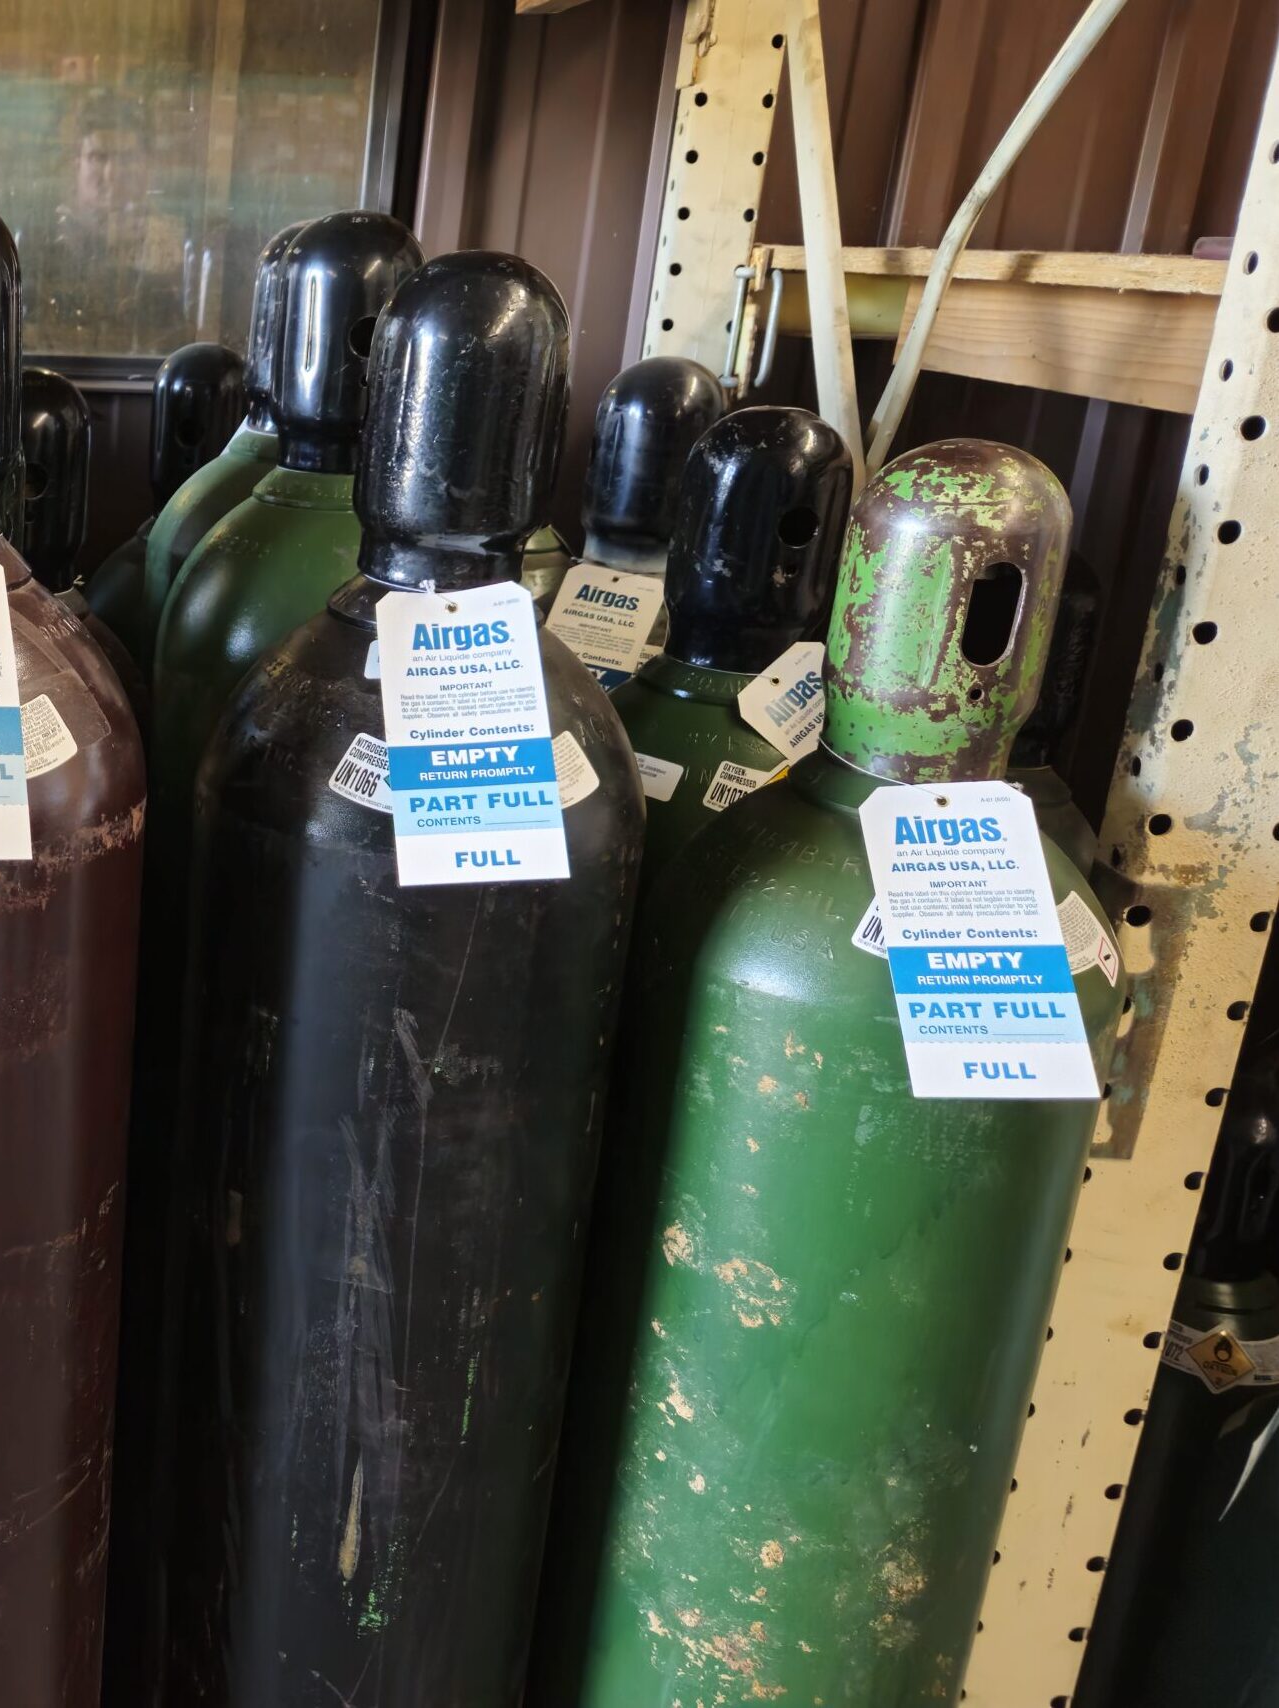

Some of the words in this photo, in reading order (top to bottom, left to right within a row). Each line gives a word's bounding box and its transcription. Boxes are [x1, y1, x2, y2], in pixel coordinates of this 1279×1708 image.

[575, 584, 639, 611] Airgas
[563, 608, 595, 619] AIRGAS
[412, 620, 510, 651] Airgas
[439, 652, 470, 662] Liquide
[472, 649, 512, 658] company
[582, 652, 622, 666] Contents:
[405, 665, 456, 677] AIRGAS
[460, 663, 492, 675] USA,
[494, 660, 523, 670] LLC.
[439, 681, 493, 691] IMPORTANT
[765, 671, 823, 728] Airgas
[409, 727, 464, 740] Cylinder
[468, 722, 534, 736] Contents:
[789, 722, 816, 748] AIRGAS
[355, 737, 388, 757] NITROGEN
[431, 745, 519, 766] EMPTY
[349, 747, 389, 771] COMPRESSE
[334, 759, 381, 798] UN1066
[420, 770, 466, 780] RETURN
[471, 766, 535, 778] PROMPTLY
[720, 771, 756, 788] COMPRESSED
[410, 794, 477, 812] PART
[487, 790, 553, 808] FULL
[417, 815, 480, 827] CONTENTS
[895, 815, 1003, 846] Airgas
[455, 849, 520, 867] FULL
[925, 848, 959, 856] Liquide
[961, 847, 1005, 855] company
[890, 861, 946, 872] AIRGAS
[949, 860, 985, 872] USA,
[987, 860, 1019, 869] LLC.
[928, 880, 988, 888] IMPORTANT
[901, 928, 962, 940] Cylinder
[965, 927, 1038, 938] Contents:
[927, 951, 1025, 968] EMPTY
[917, 975, 969, 984] RETURN
[972, 975, 1043, 984] PROMPTLY
[908, 1002, 984, 1018] PART
[992, 1002, 1066, 1018] FULL
[919, 1025, 988, 1034] CONTENTS
[963, 1062, 1036, 1079] FULL
